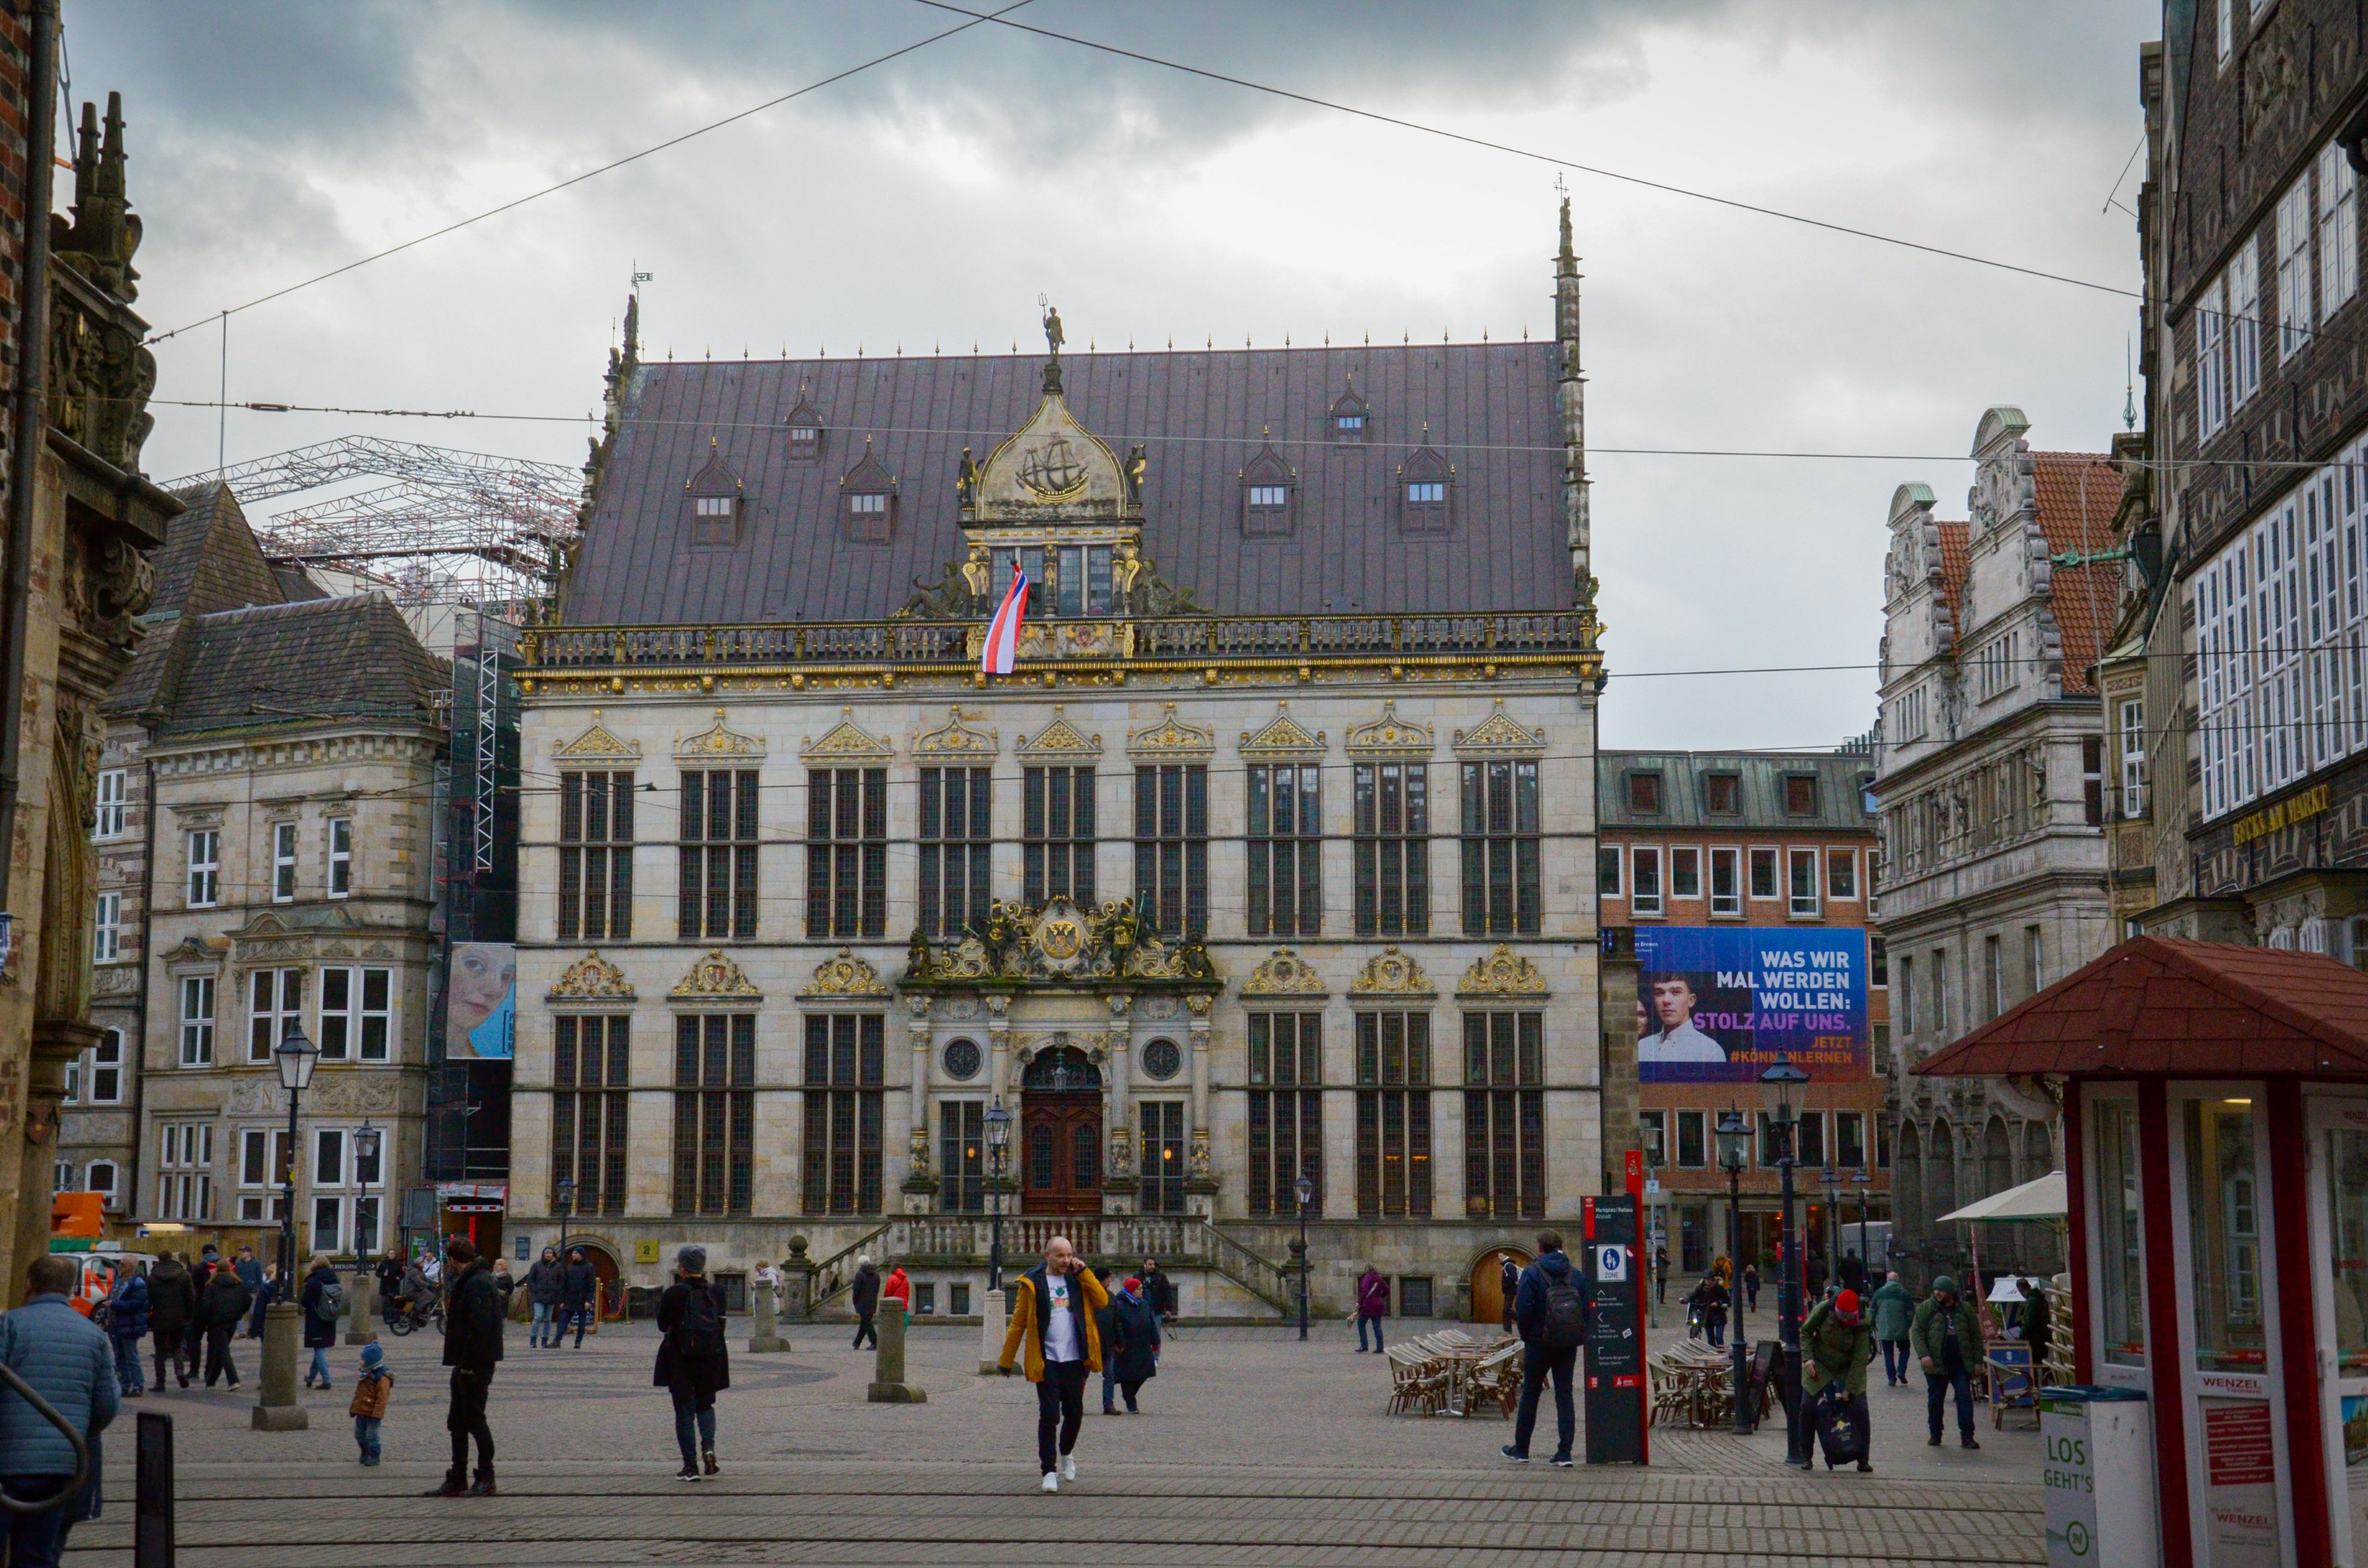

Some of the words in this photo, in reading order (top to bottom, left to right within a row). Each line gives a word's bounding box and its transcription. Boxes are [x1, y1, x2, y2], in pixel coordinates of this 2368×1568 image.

[2269, 803, 2286, 833] AM
[2287, 784, 2330, 825] MARKT
[1761, 951, 1806, 968] WAS
[1810, 951, 1850, 968] WIR
[1717, 971, 1759, 988] MAL
[1763, 972, 1850, 989] WERDEN
[1759, 992, 1851, 1009] WOLLEN:
[1693, 1012, 1755, 1030] STOLZ
[1759, 1013, 1799, 1030] AUF
[1805, 1013, 1851, 1031] UNS.
[1812, 1036, 1852, 1048] JETZT
[643, 1245, 651, 1255] 2
[2203, 1377, 2260, 1389] WENZEL
[2048, 1435, 2086, 1466] LOS
[2044, 1469, 2094, 1493] GEHT'S
[2216, 1513, 2269, 1524] WENZEL
